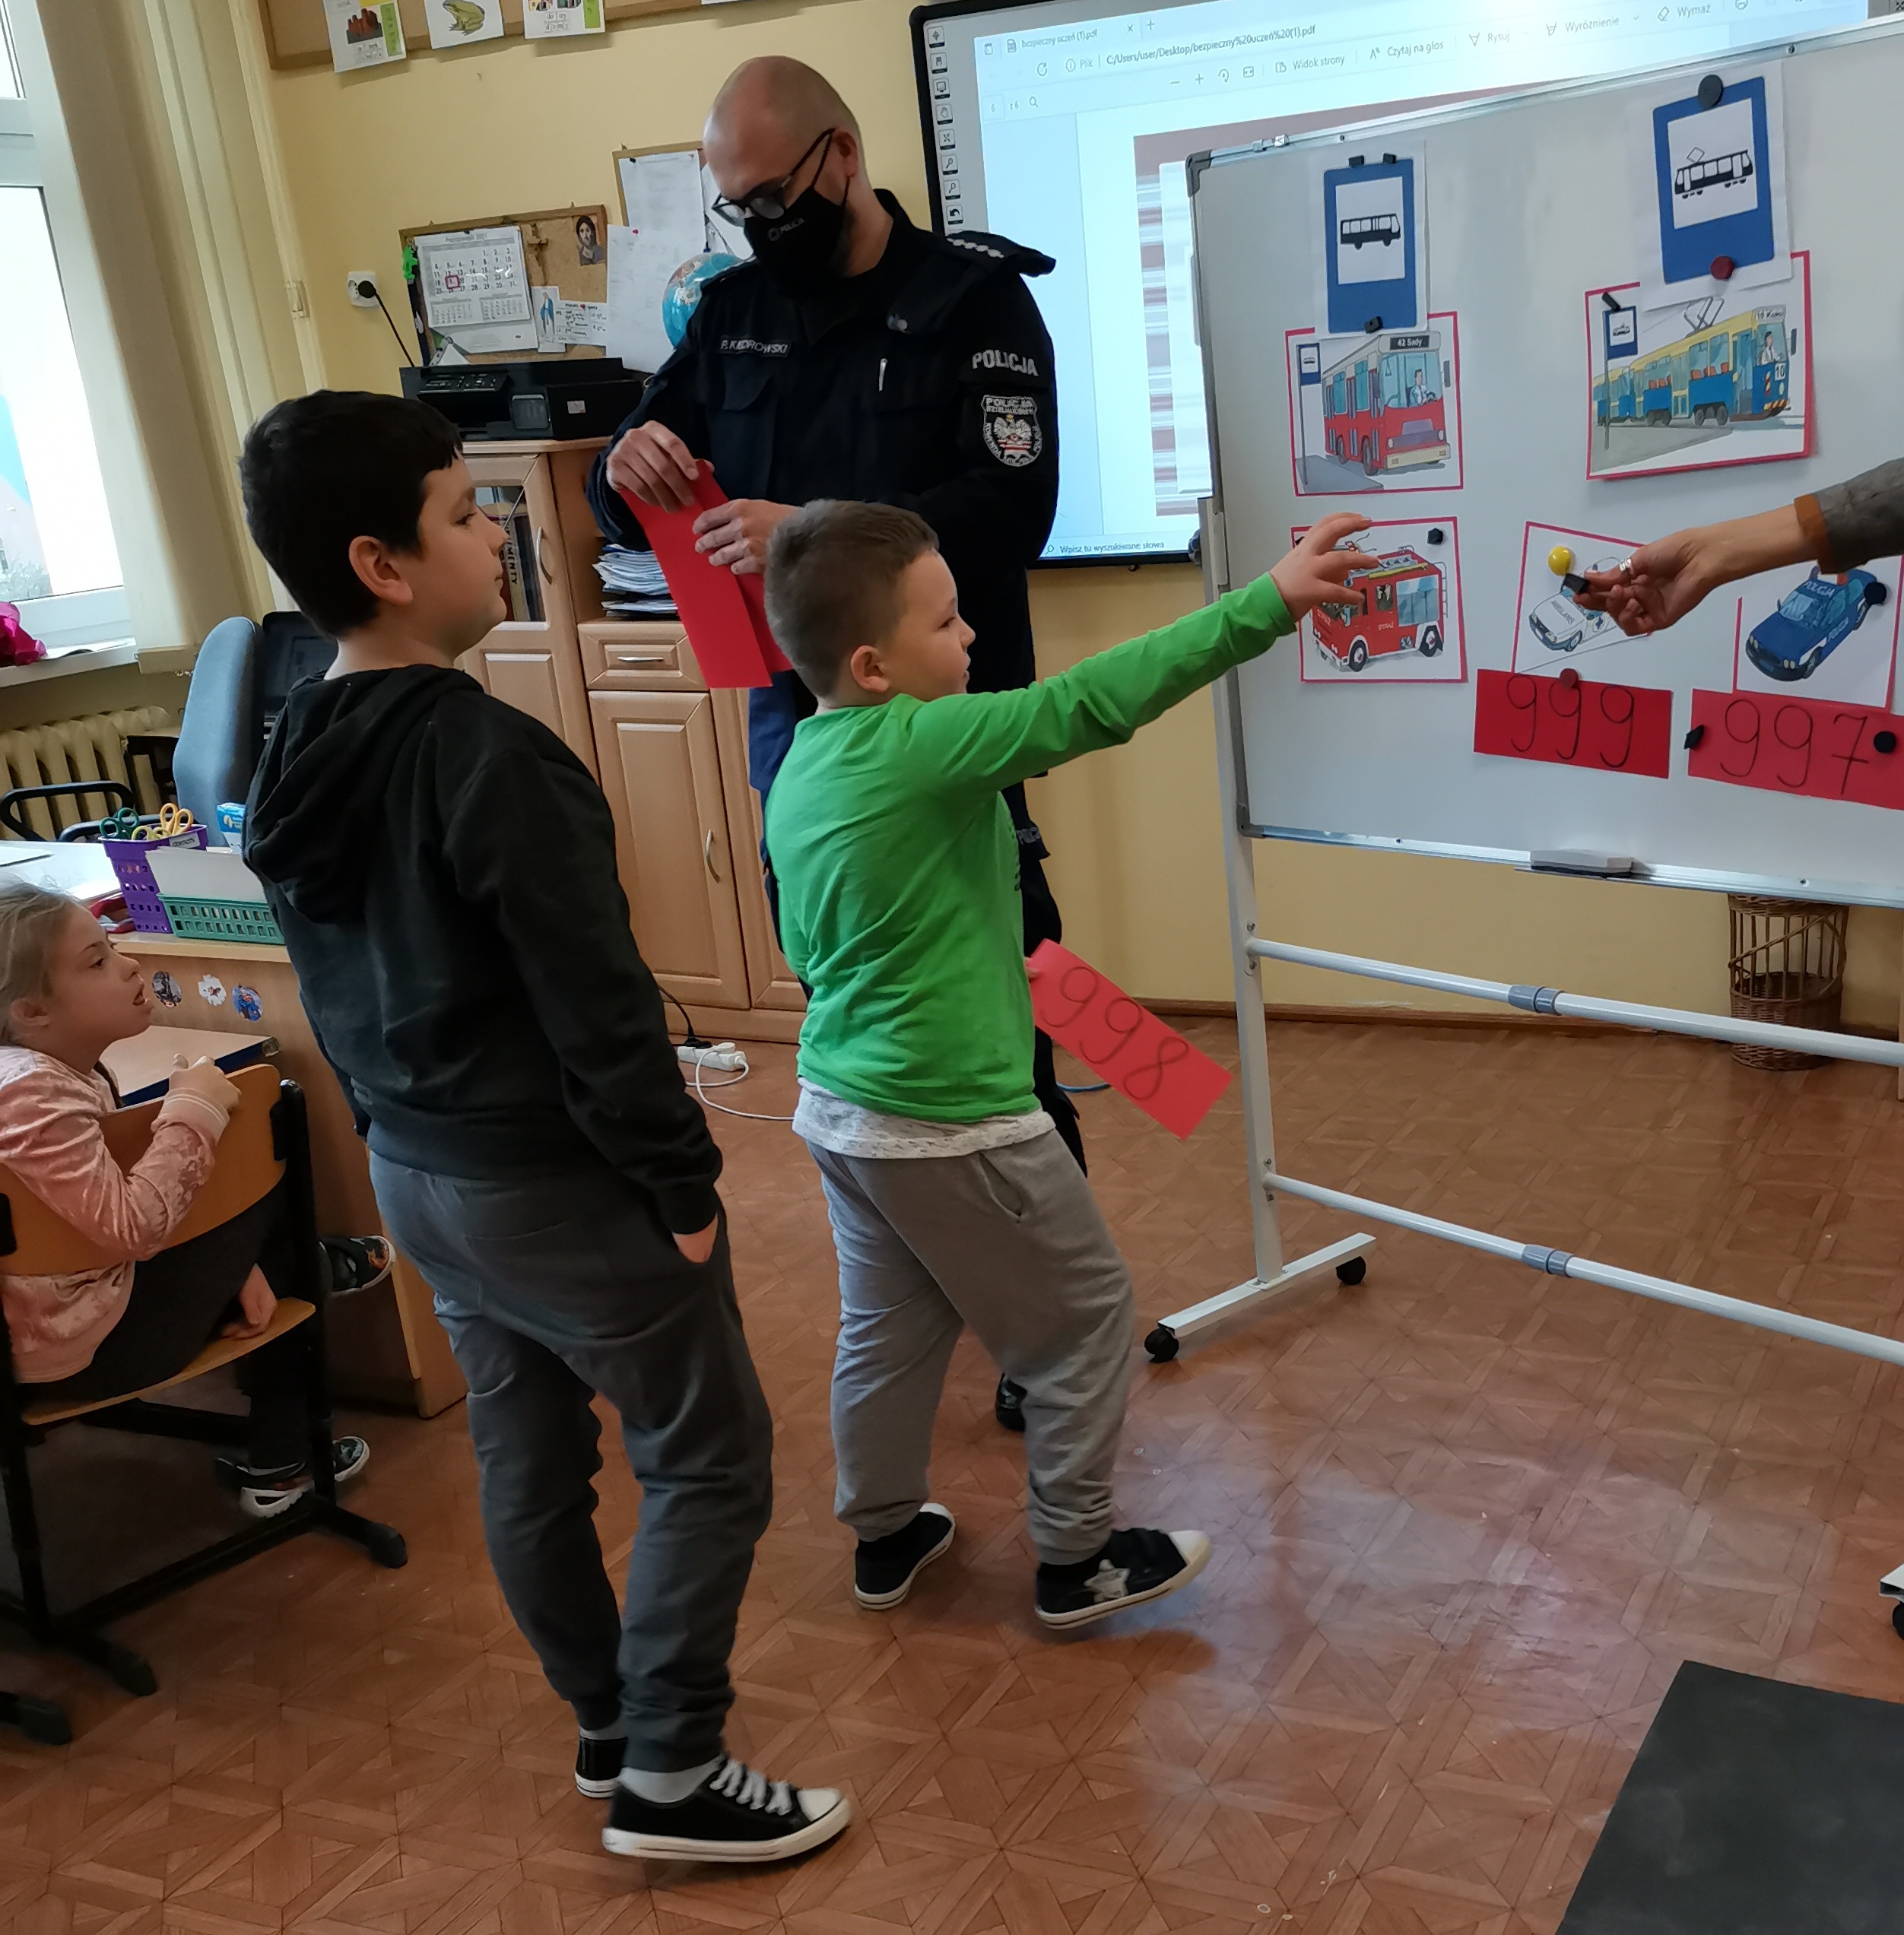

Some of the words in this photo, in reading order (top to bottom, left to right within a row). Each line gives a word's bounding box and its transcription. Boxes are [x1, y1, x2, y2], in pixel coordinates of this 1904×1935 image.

[1565, 17, 1620, 33] Wyróżnienie
[1487, 32, 1510, 43] Rysuj
[1387, 44, 1412, 58] Czytaj
[1414, 43, 1424, 52] na
[1292, 57, 1319, 70] Widok
[1320, 56, 1345, 67] strony
[1397, 338, 1407, 347] 42
[1407, 338, 1423, 347] Sady
[972, 350, 1039, 376] POLICJA
[1775, 365, 1785, 379] 10
[1506, 674, 1635, 768] 999
[1719, 698, 1870, 795] 997
[1040, 965, 1190, 1100] 998
